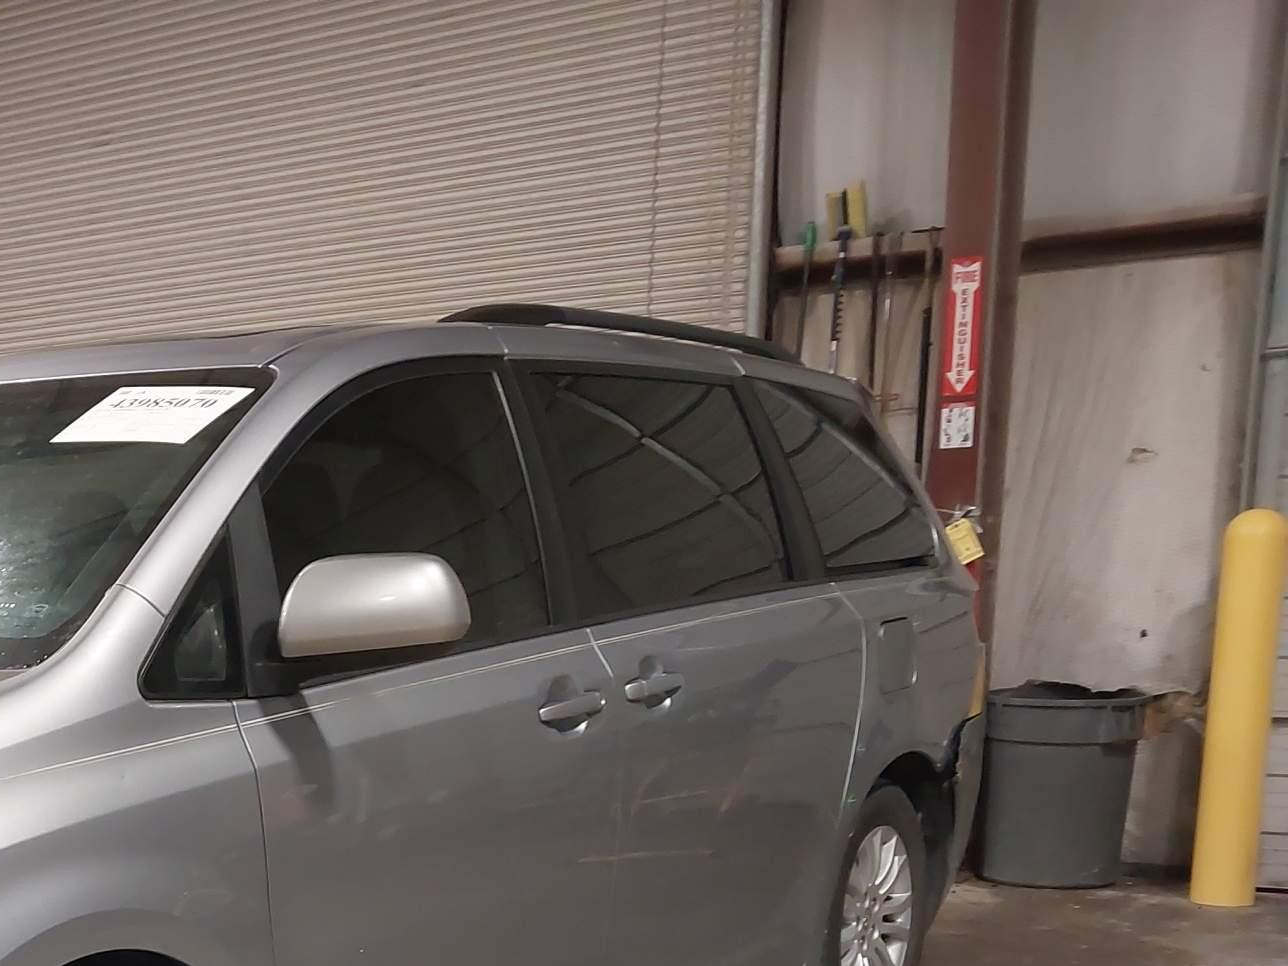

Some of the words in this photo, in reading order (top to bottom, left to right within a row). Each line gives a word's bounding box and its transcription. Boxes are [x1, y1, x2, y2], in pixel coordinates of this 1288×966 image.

[954, 270, 979, 284] FIRE
[954, 288, 969, 385] EXTINGUISHER
[110, 397, 218, 409] 43985070
